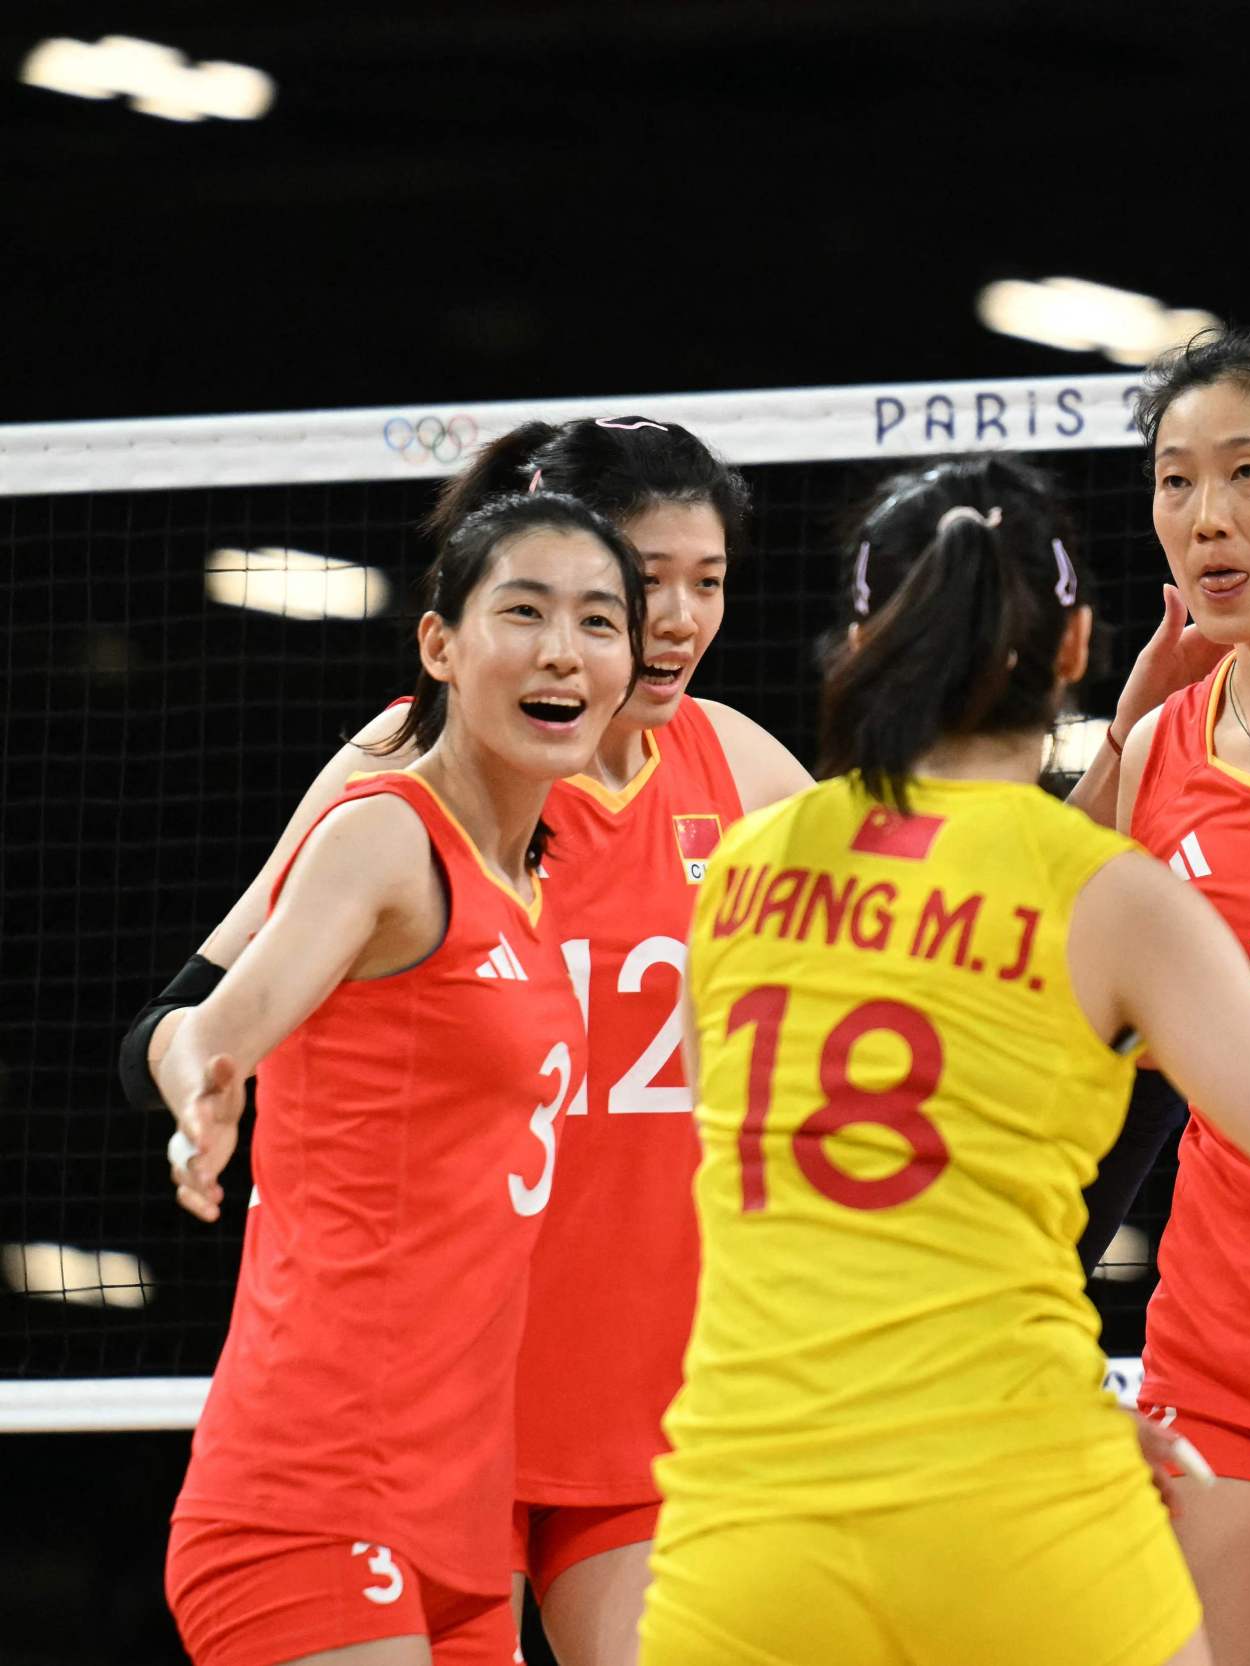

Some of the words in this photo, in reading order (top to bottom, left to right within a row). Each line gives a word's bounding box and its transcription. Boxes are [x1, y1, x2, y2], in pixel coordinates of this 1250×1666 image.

[713, 864, 898, 951] WANG
[508, 1041, 571, 1217] 3
[725, 983, 951, 1215] 18
[351, 1541, 403, 1605] 3
